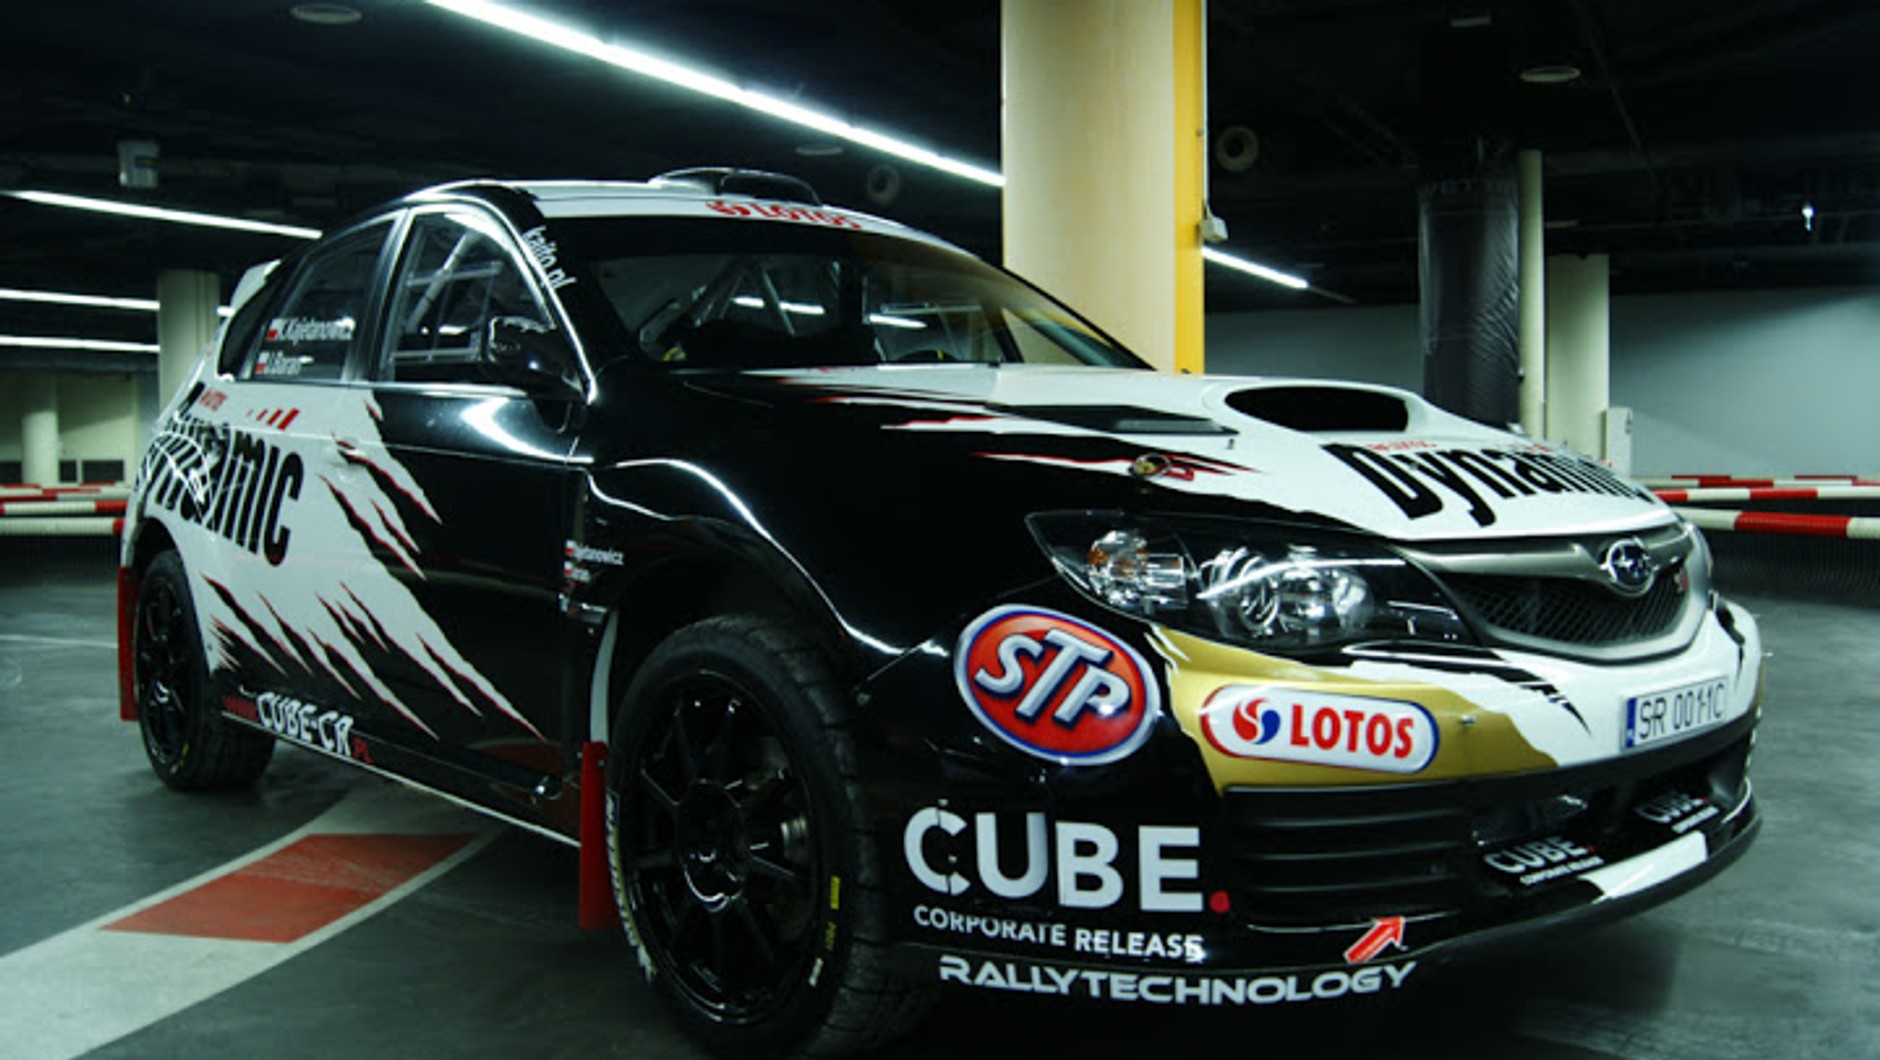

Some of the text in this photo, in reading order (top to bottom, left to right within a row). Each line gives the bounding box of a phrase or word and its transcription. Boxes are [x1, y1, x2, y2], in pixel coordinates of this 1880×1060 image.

[973, 627, 1131, 728] STP
[1290, 703, 1415, 760] LOTOS
[1639, 697, 1667, 740] SR
[914, 904, 1206, 965] CORPORATE RELEASE
[939, 955, 1417, 1006] RALLYTECHNOLOGY
